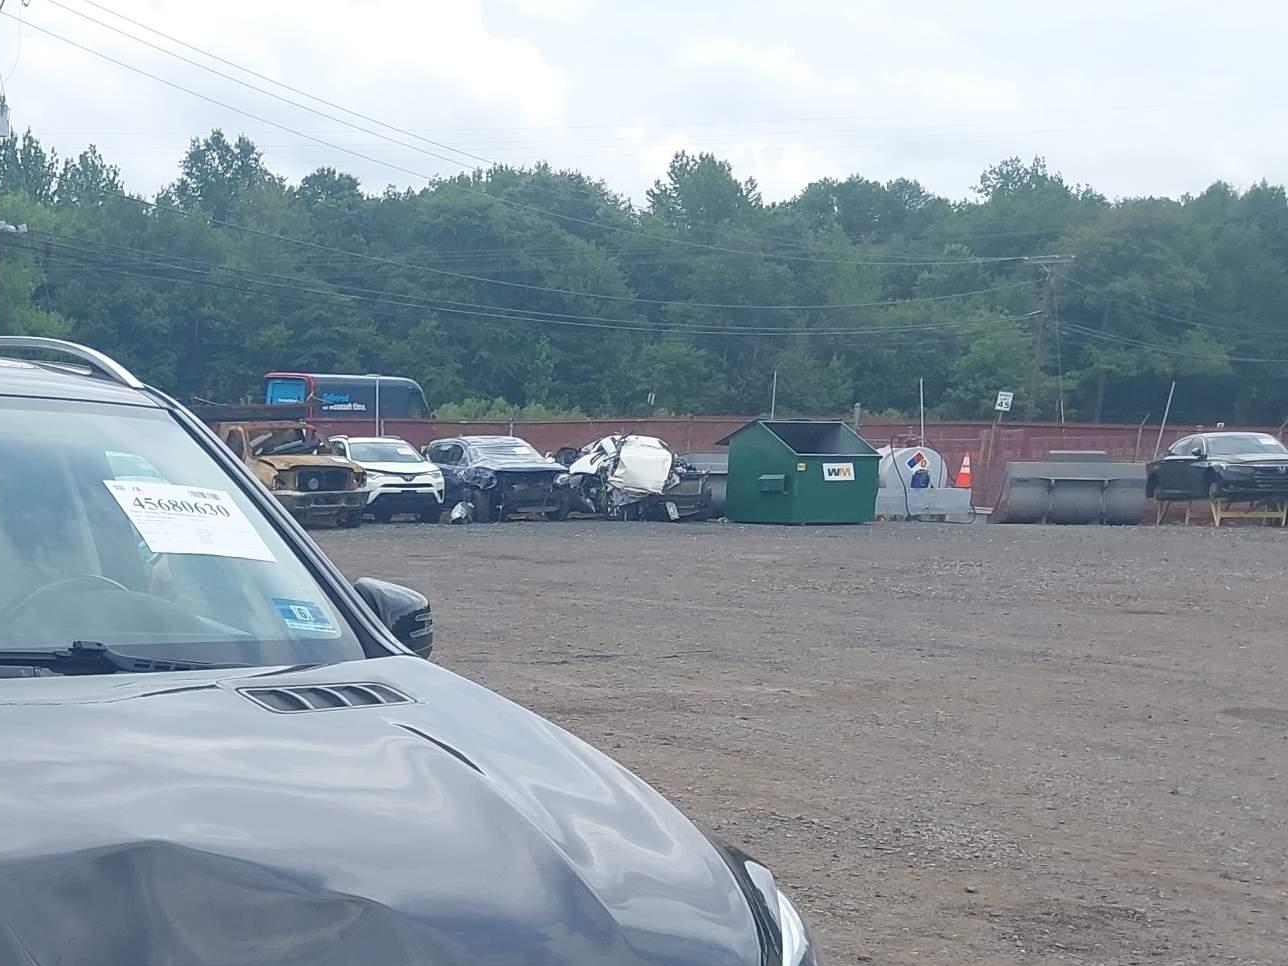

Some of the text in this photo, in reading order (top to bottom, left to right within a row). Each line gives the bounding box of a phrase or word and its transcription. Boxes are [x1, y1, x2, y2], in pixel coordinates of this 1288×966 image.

[997, 401, 1010, 409] 45
[827, 467, 851, 477] WM
[133, 496, 231, 518] 45680630
